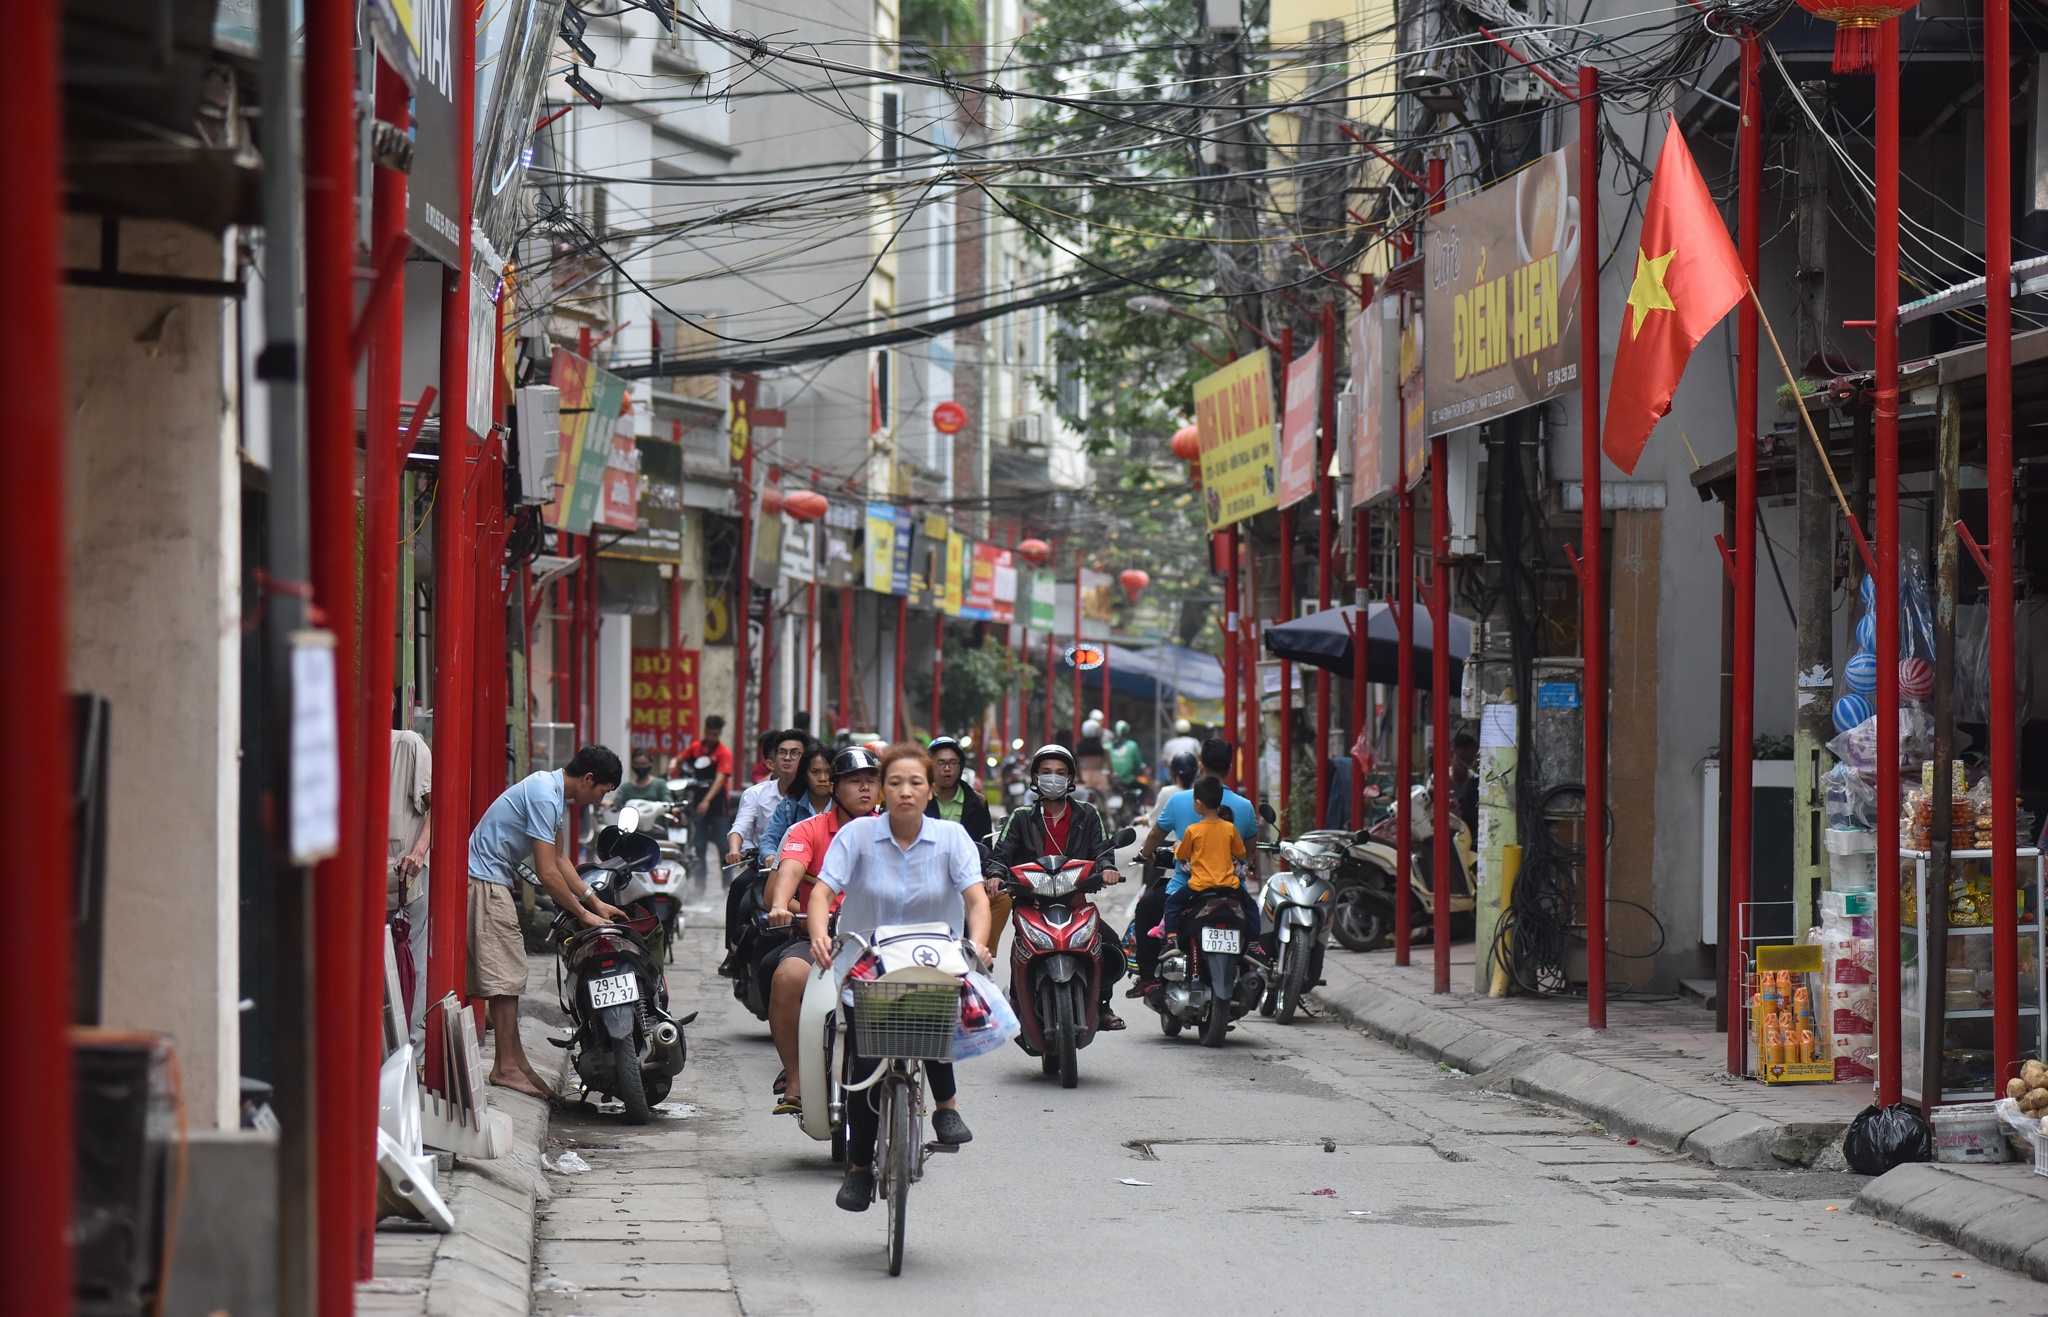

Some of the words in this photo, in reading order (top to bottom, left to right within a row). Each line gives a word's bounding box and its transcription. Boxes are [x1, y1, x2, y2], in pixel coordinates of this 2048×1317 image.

[1453, 246, 1507, 382] ĐIỂM
[1513, 251, 1558, 376] HẸN
[634, 649, 692, 675] BÚN
[633, 678, 693, 704] ĐẬU
[1209, 930, 1234, 941] 29-L1
[1205, 940, 1238, 952] 707.35
[595, 975, 628, 993] 29-L1
[593, 987, 634, 1006] 622.37
